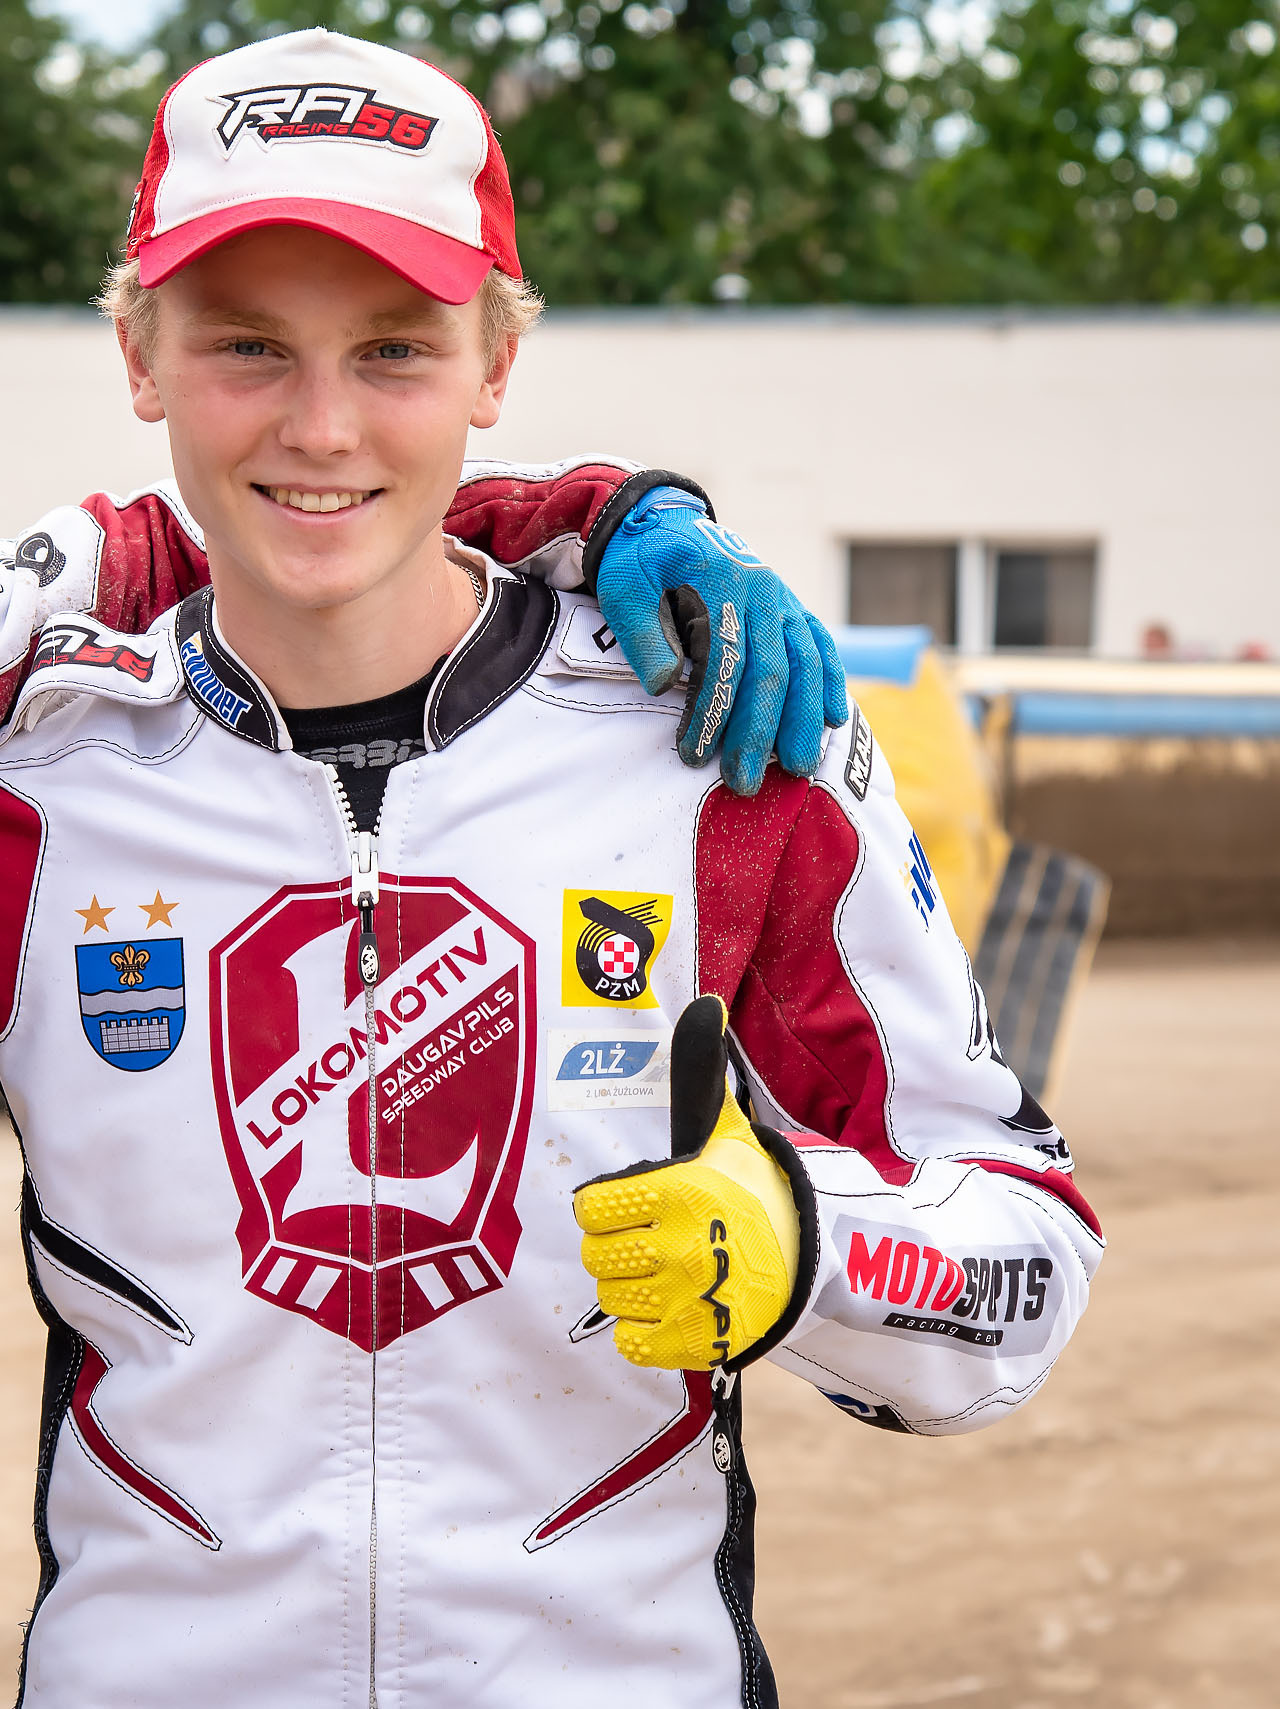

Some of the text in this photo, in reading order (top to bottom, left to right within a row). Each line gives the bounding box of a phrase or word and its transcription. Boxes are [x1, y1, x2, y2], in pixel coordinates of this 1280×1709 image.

[261, 123, 352, 137] RACING
[595, 977, 641, 998] PZM
[246, 926, 489, 1151] LOKOMOTIV
[382, 985, 515, 1098] DAUGAVPILS
[382, 1016, 515, 1125] SPEEDWAY CLUB
[893, 1316, 959, 1336] racing
